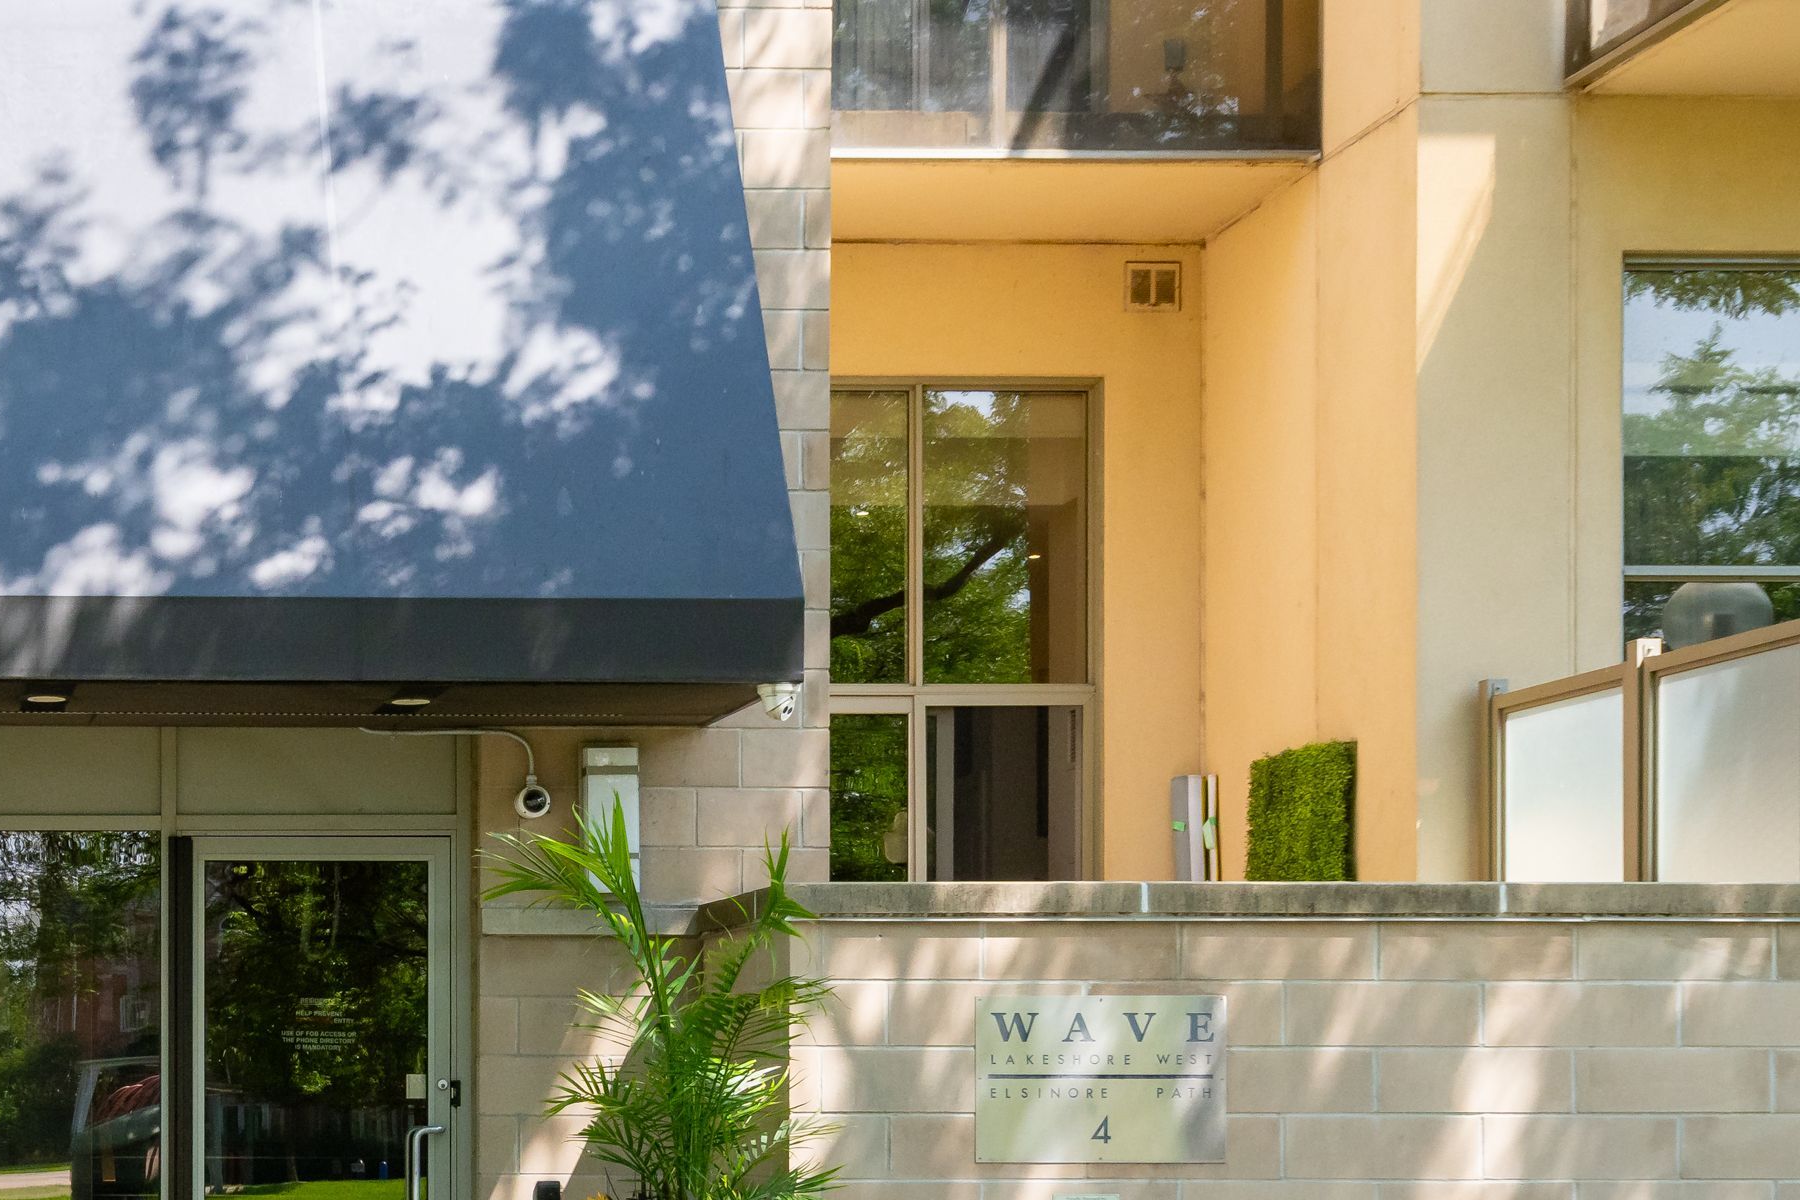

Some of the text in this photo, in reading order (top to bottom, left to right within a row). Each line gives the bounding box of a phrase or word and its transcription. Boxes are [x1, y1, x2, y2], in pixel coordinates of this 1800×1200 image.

[990, 1012, 1214, 1042] WAVE
[320, 1030, 346, 1038] ACCESS
[990, 1053, 1212, 1065] LAKESHORE WEST
[990, 1087, 1211, 1099] ELSINORE PATH
[1091, 1115, 1112, 1144] 4
